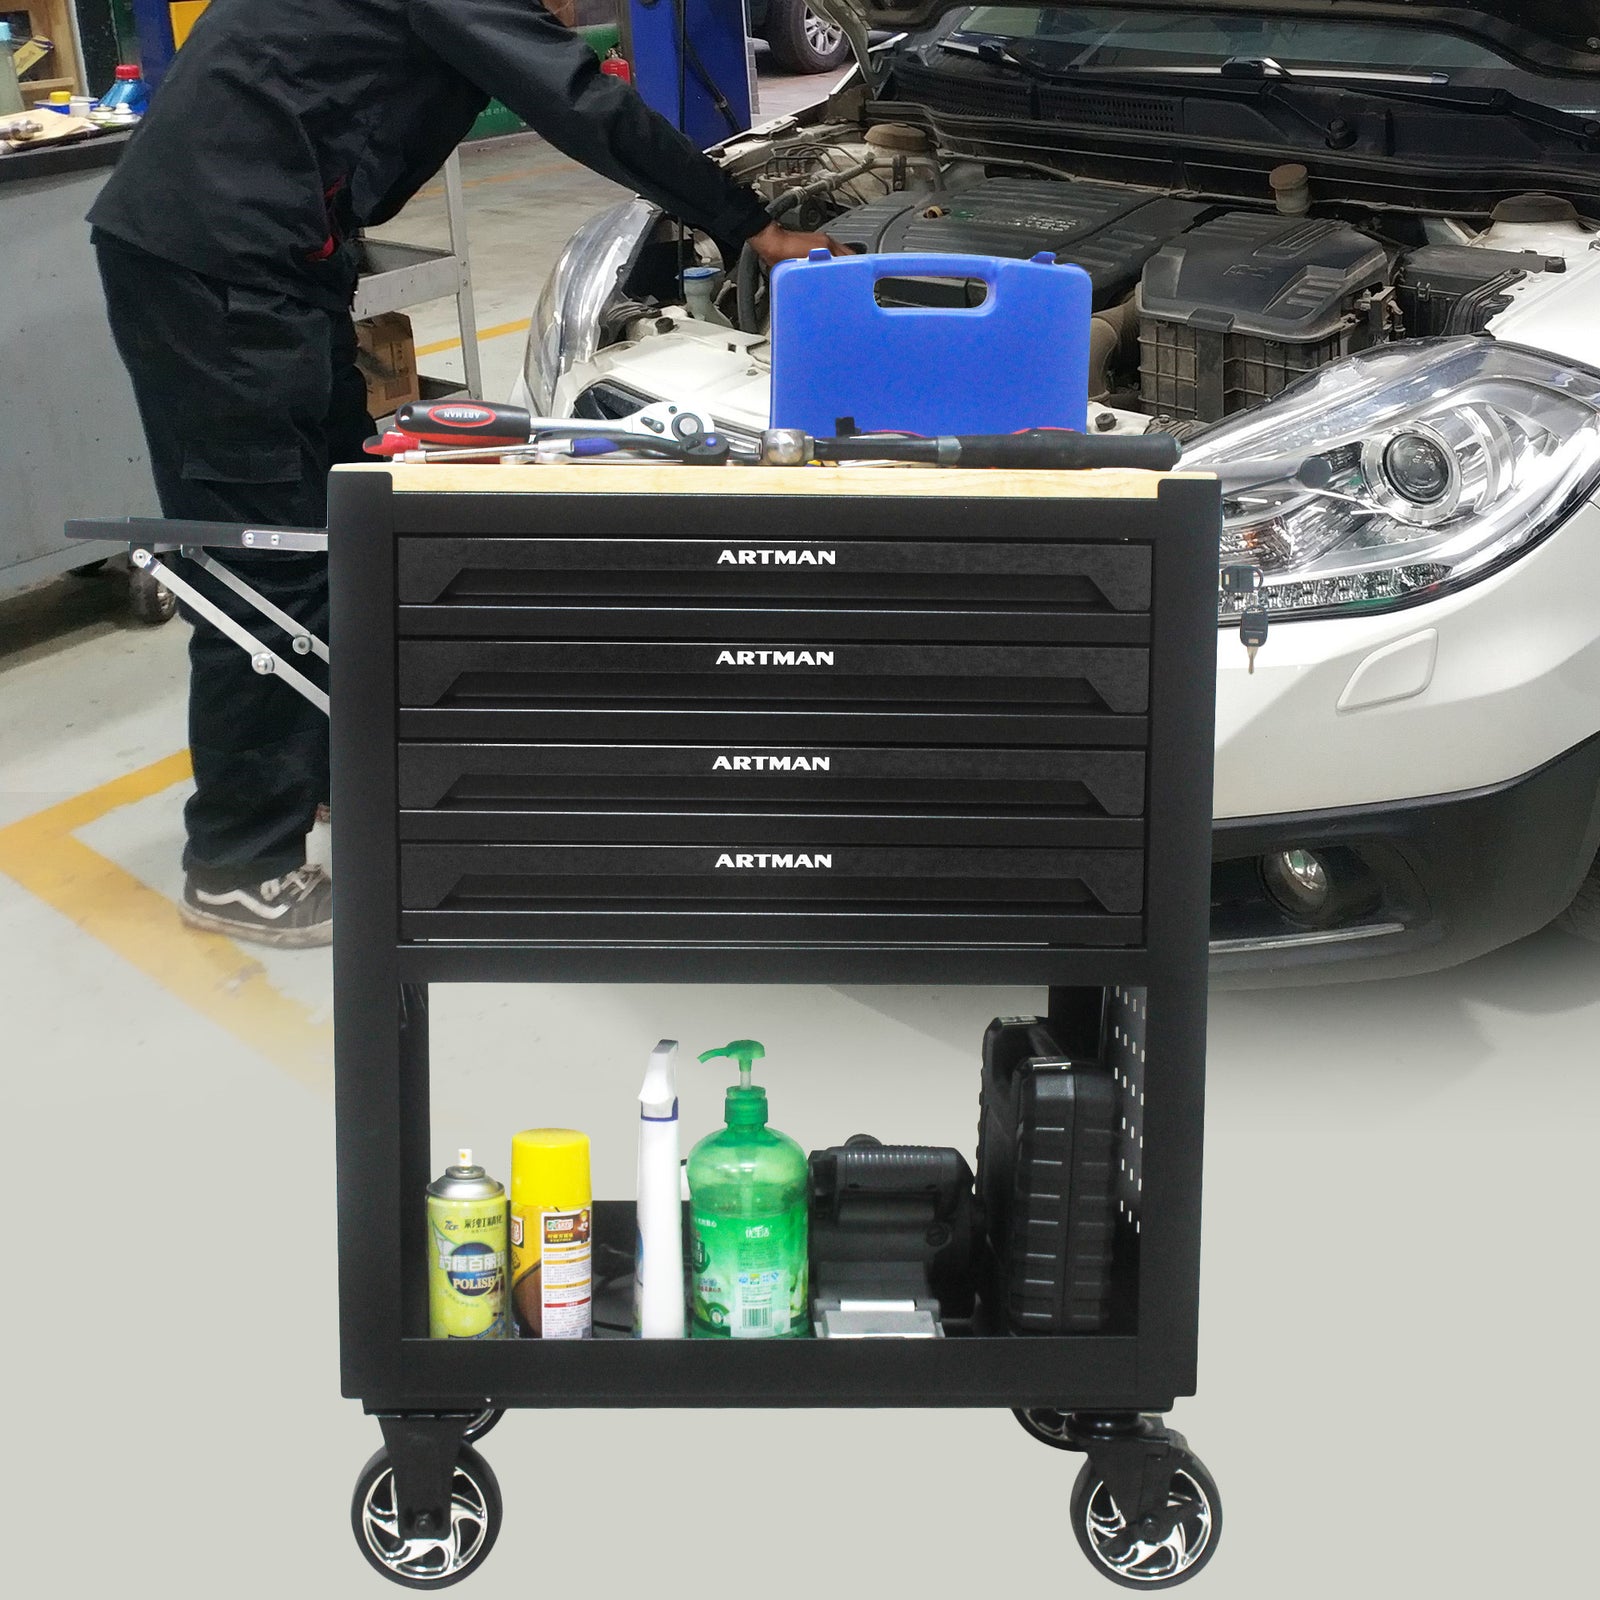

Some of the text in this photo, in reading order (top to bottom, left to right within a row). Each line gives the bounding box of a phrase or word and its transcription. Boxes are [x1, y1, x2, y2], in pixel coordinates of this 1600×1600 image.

[444, 411, 480, 419] ARTMAN
[717, 550, 835, 564] ARTMAN
[716, 651, 833, 665] ARTMAN
[712, 756, 829, 770] ARTMAN
[715, 854, 831, 868] ARTMAN
[452, 1276, 495, 1290] POLISH
